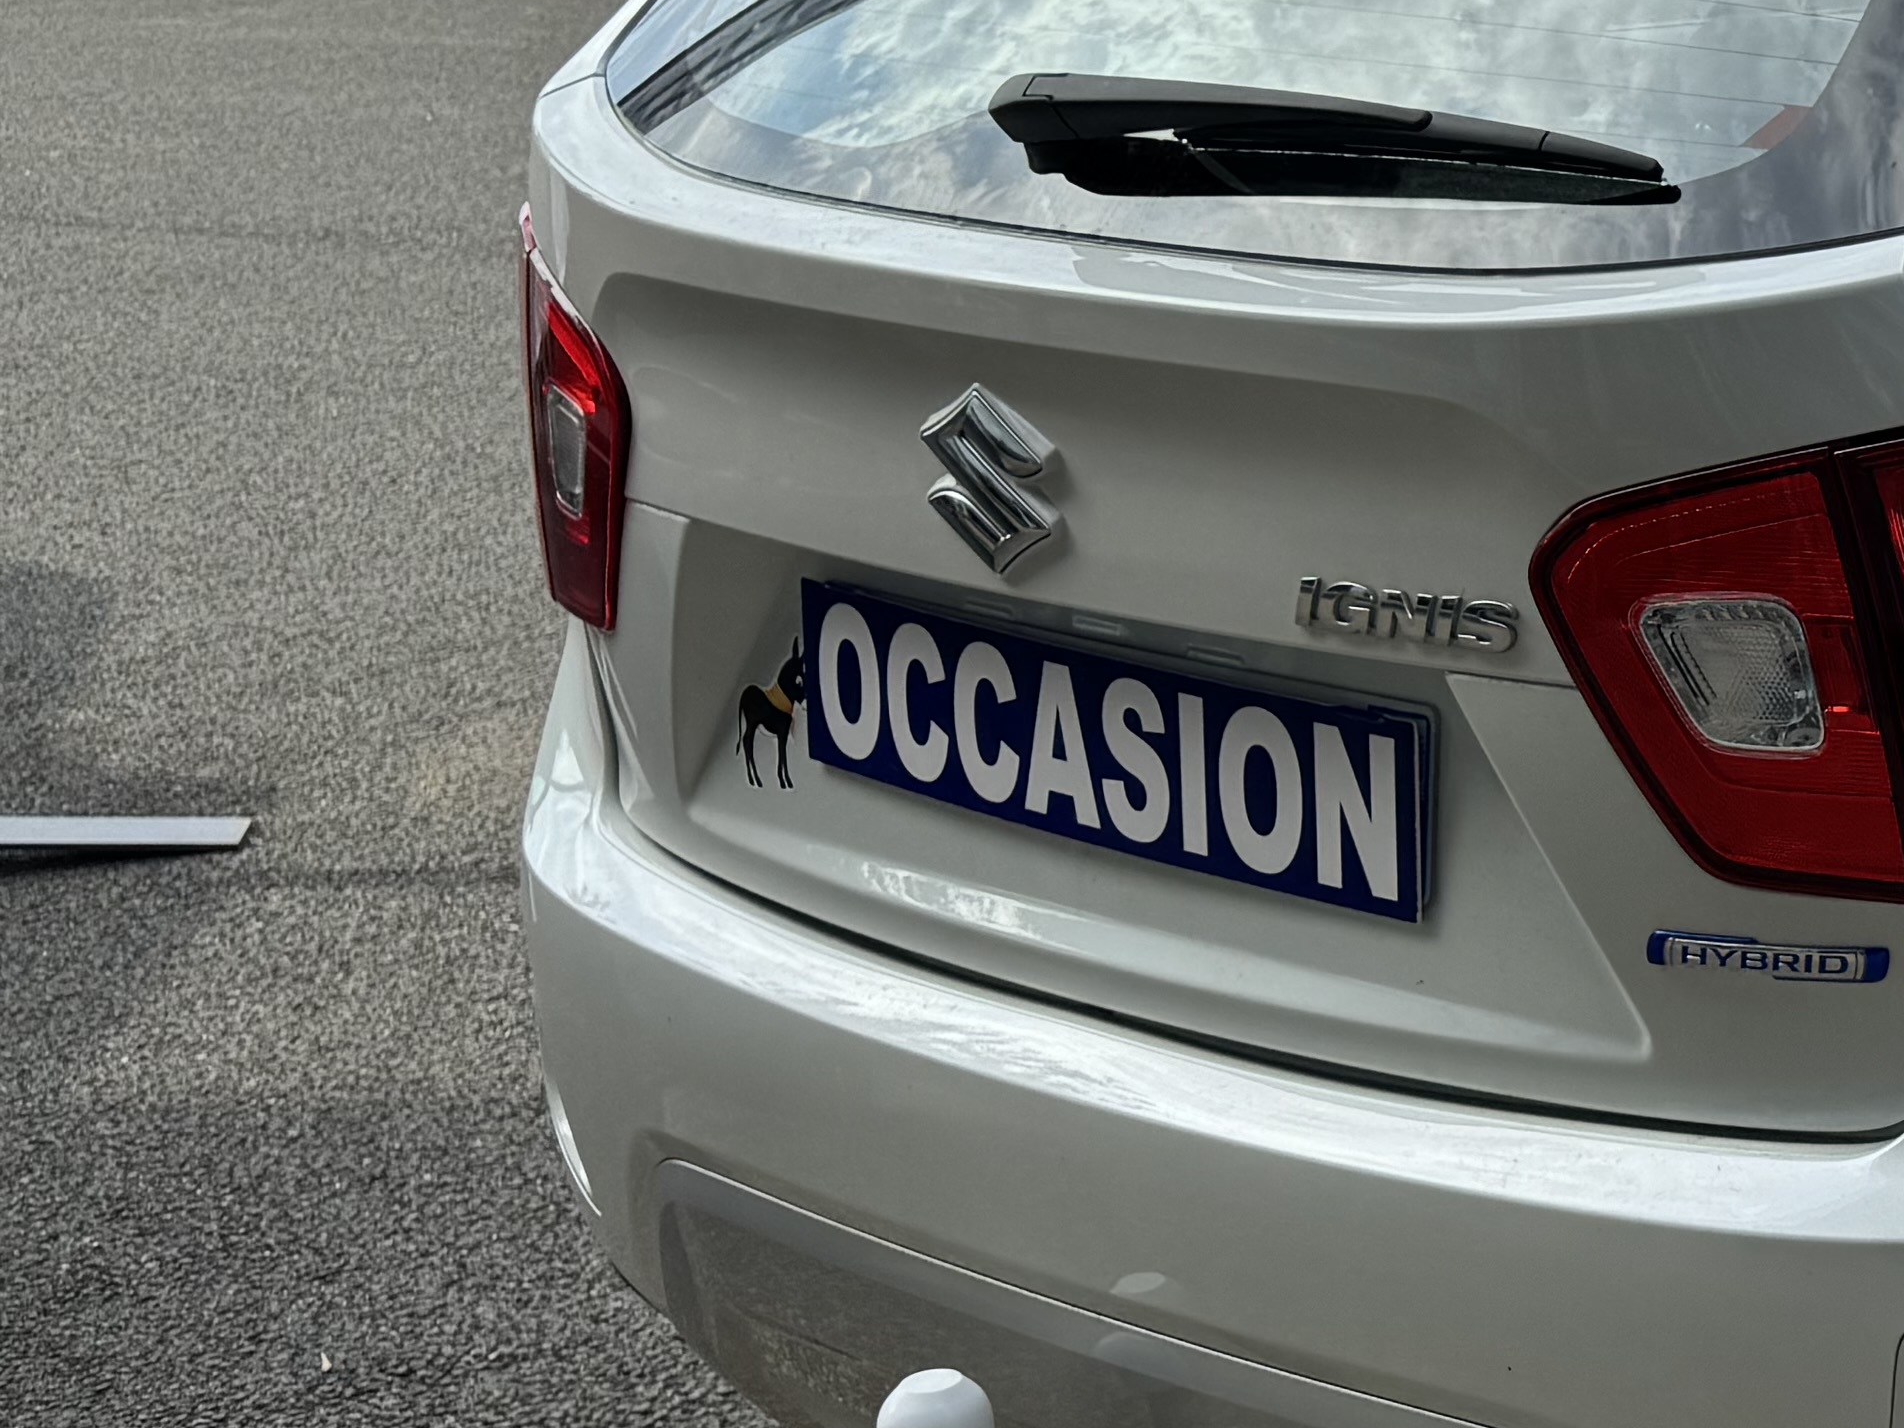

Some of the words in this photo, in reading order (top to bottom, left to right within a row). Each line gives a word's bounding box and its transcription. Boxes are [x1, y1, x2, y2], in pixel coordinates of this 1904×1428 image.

[1296, 576, 1520, 653] IGNIS
[818, 602, 1398, 902] OCCASION
[1681, 945, 1849, 974] HYBRID
